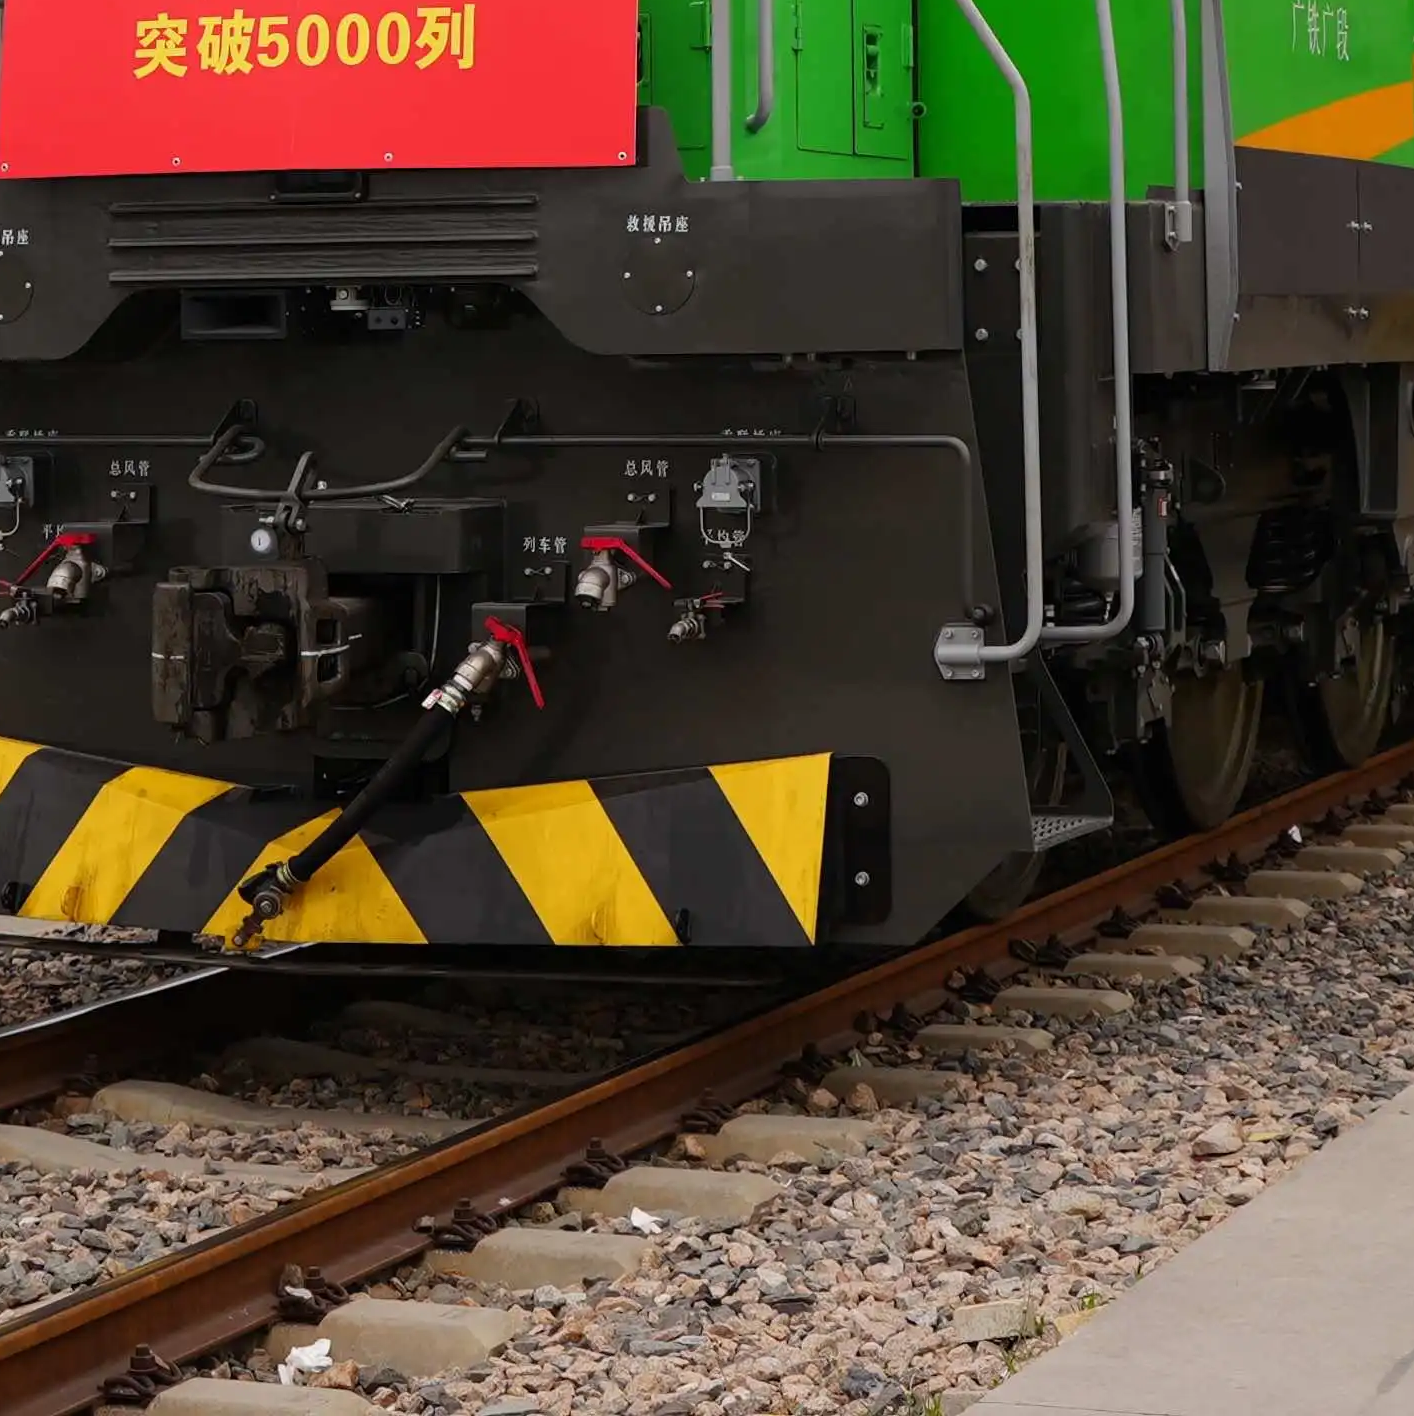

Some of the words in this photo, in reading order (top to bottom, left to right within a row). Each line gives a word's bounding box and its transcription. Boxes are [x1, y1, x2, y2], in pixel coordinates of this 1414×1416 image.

[133, 4, 476, 80] 突破5000列
[627, 214, 689, 233] 救援吊座
[109, 460, 150, 477] 总风管
[624, 460, 670, 477] 总风管
[523, 537, 567, 554] 列车管
